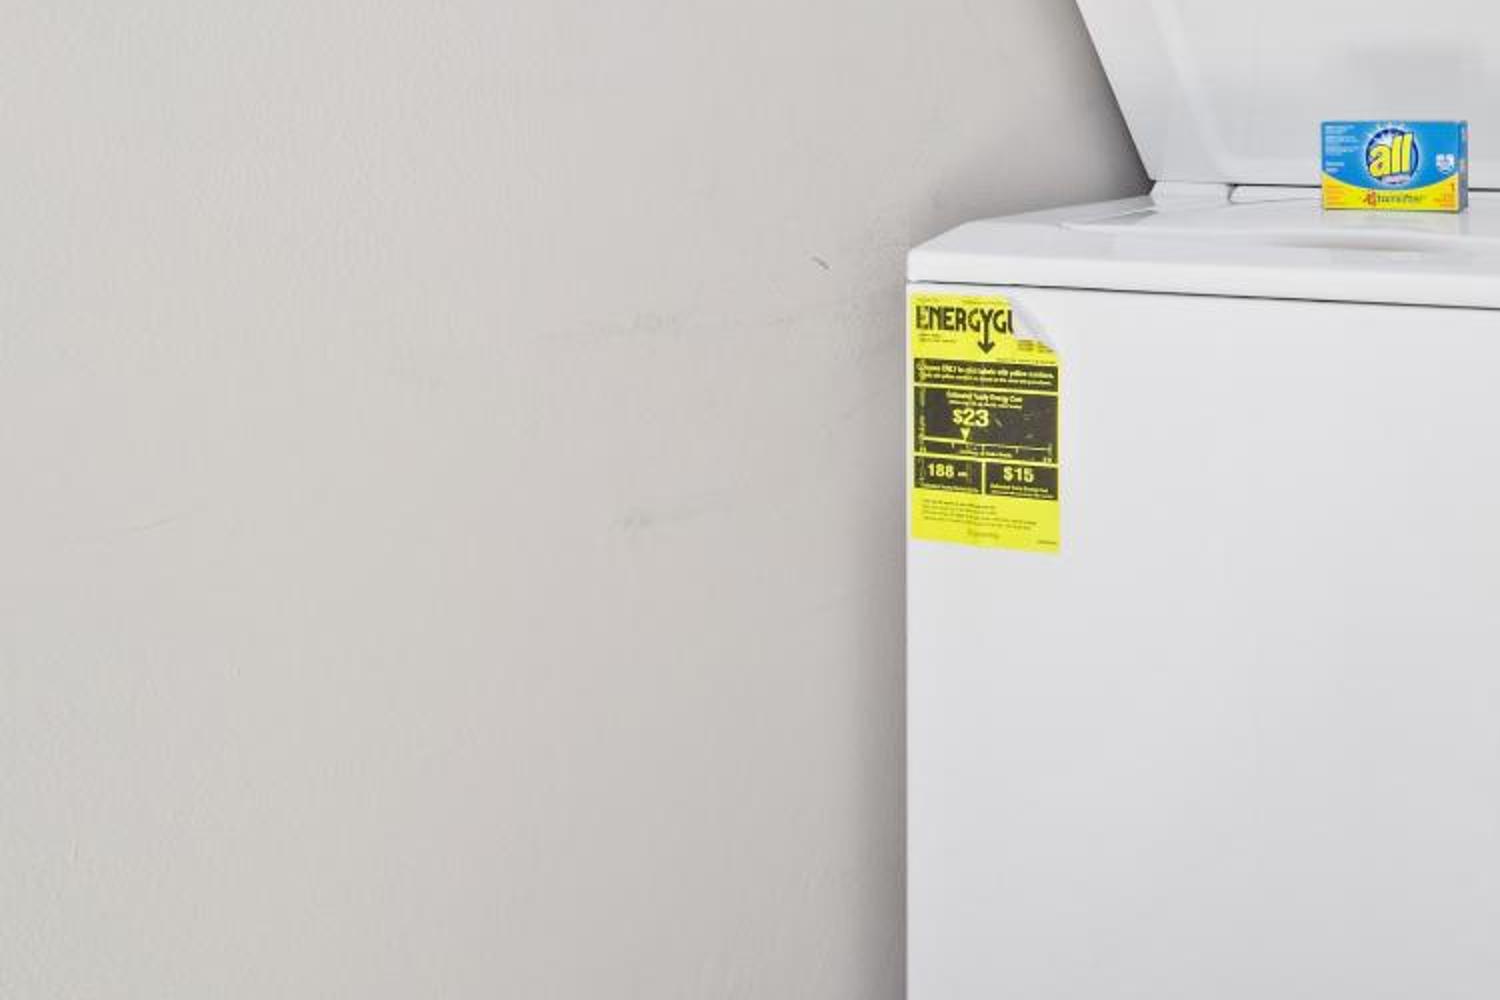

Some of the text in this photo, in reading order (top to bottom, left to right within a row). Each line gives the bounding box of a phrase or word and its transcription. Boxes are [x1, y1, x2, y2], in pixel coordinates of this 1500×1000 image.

[1368, 131, 1413, 178] all
[953, 408, 989, 428] $23
[927, 463, 955, 478] 188
[1003, 465, 1035, 483] $15
